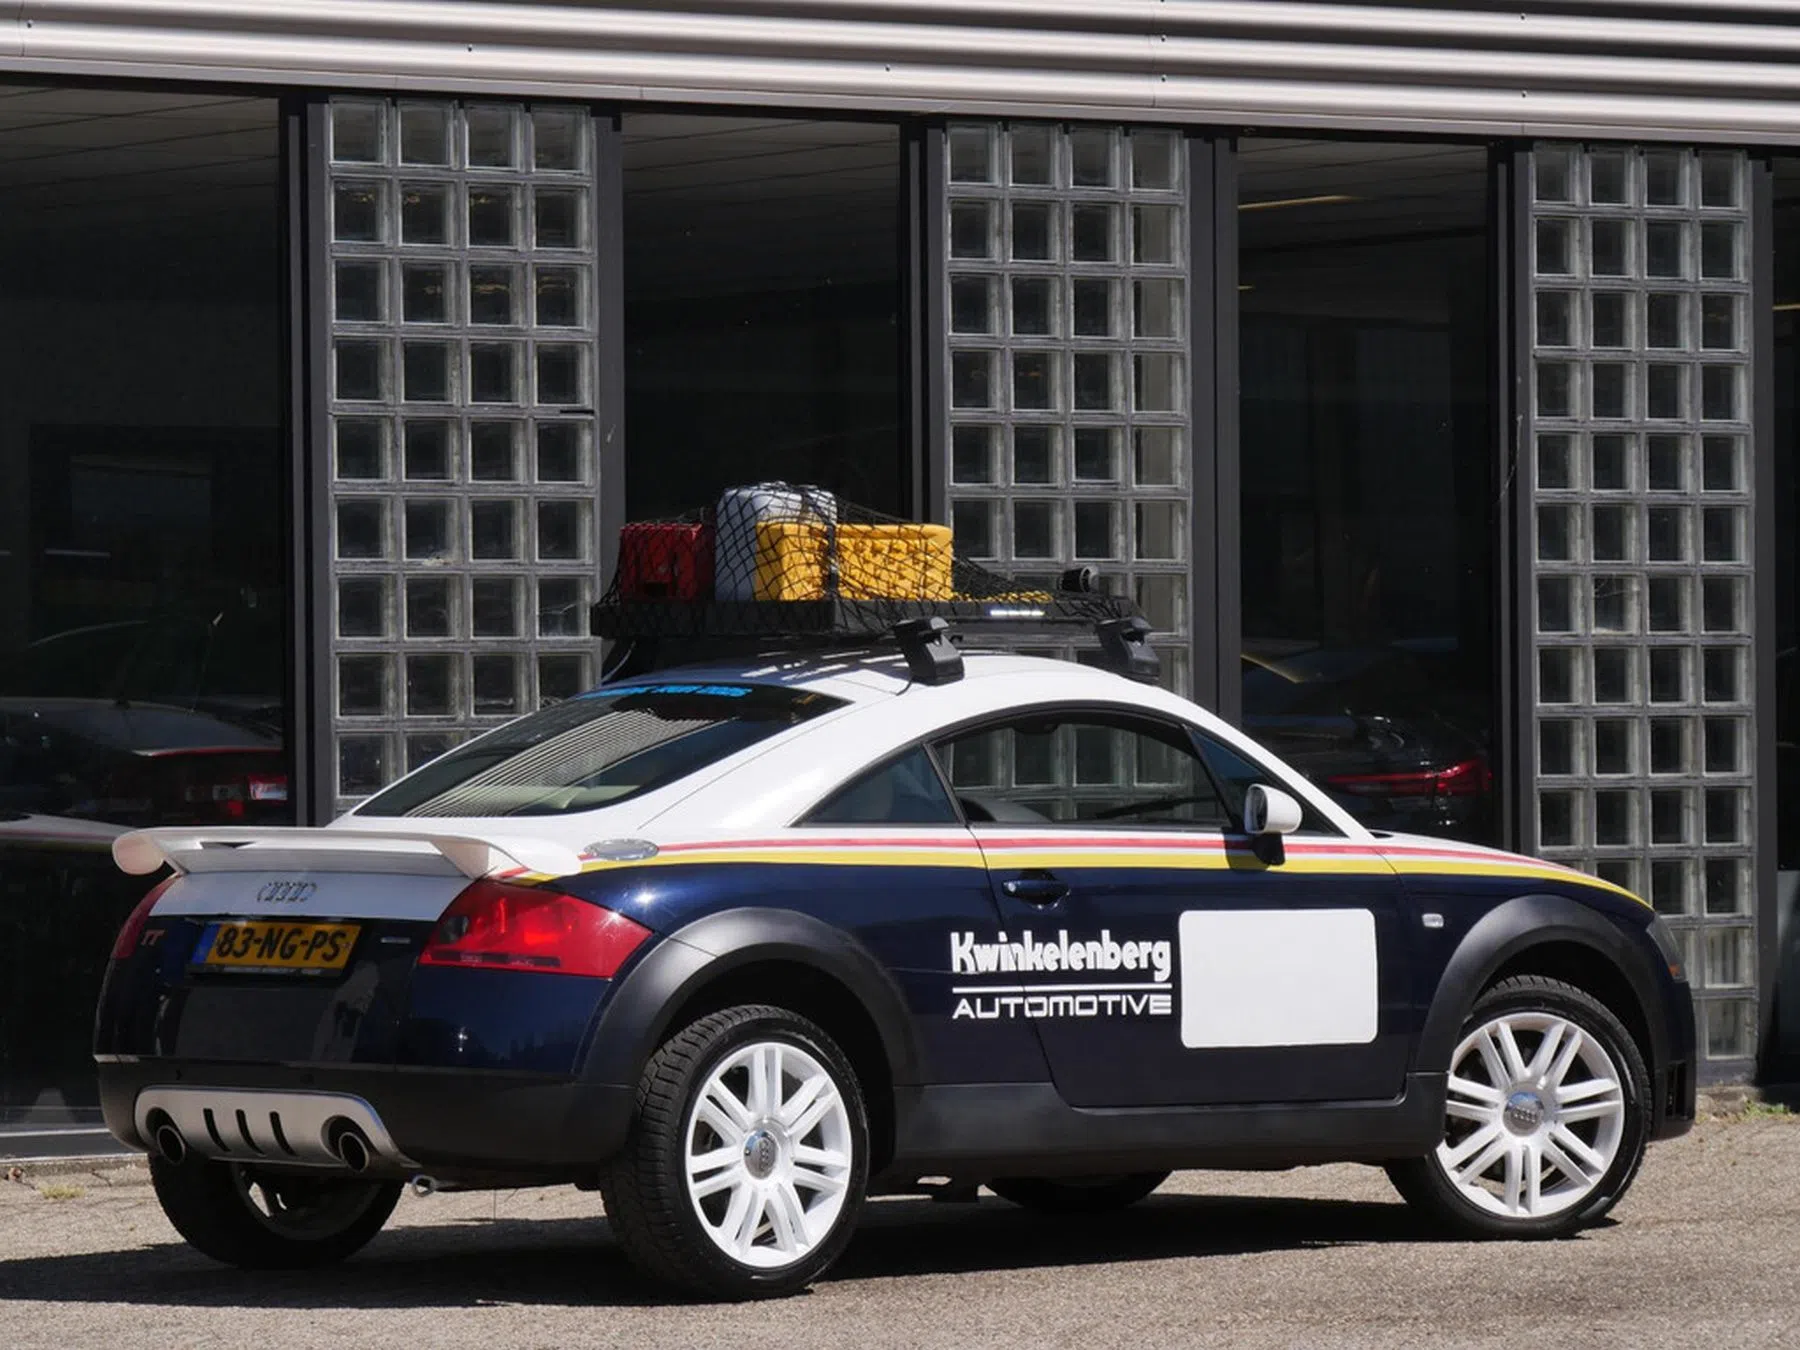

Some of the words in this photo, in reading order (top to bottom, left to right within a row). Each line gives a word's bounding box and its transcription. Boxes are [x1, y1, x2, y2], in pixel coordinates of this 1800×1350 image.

[141, 929, 165, 946] TT
[216, 927, 346, 962] 83-NG-PS
[950, 929, 1172, 982] Kwinkelenberg
[952, 994, 1172, 1019] AUTOMOTIVE
